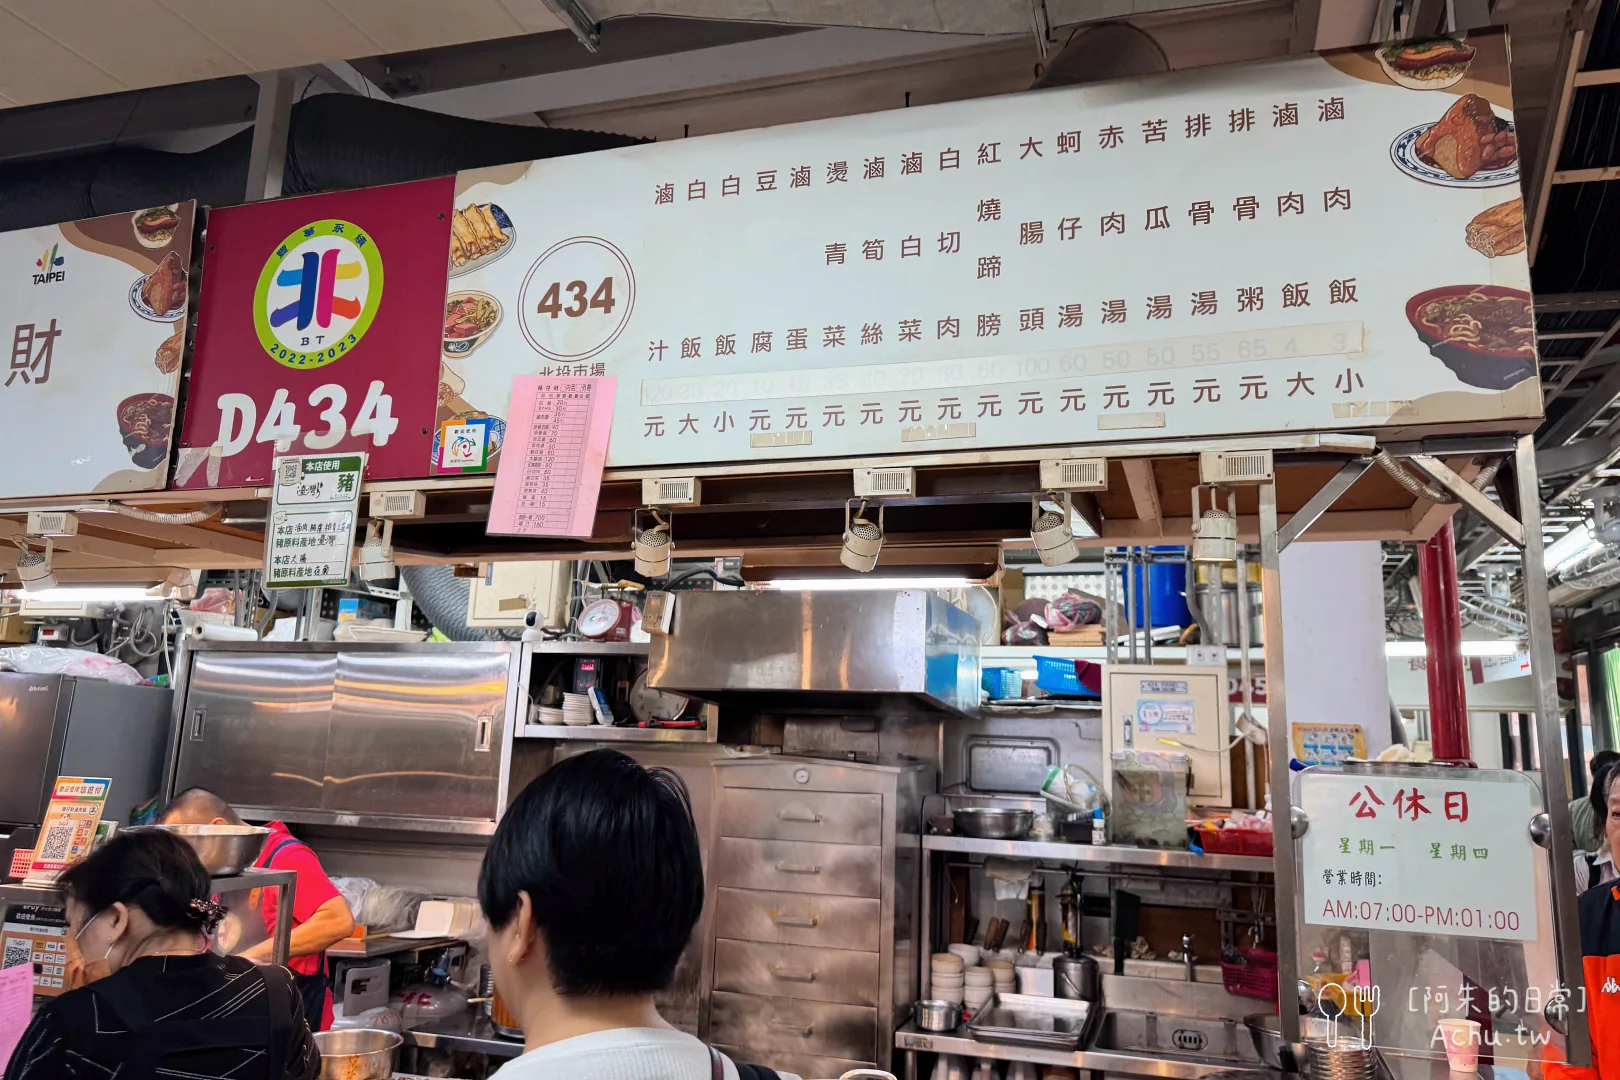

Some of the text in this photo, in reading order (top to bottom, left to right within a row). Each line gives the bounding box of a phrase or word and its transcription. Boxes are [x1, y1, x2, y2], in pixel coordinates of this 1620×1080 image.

[32, 271, 65, 285] TAIPEI
[537, 277, 615, 319] 434
[4, 318, 62, 387] 財
[270, 333, 357, 364] 2022-2023
[1102, 350, 1129, 369] 50
[1146, 346, 1174, 365] 50
[1191, 343, 1220, 361] 55
[1237, 339, 1267, 359] 65
[1060, 354, 1086, 371] 60
[1193, 379, 1220, 403] 元
[1240, 375, 1268, 400] 元
[1287, 372, 1315, 397] 大
[1335, 368, 1364, 393] 小
[1019, 392, 1043, 415] 元
[1060, 388, 1086, 412] 元
[1103, 385, 1129, 409] 元
[1148, 382, 1174, 406] 元
[823, 405, 845, 427] 元
[861, 403, 883, 425] 元
[899, 400, 922, 422] 元
[938, 398, 961, 420] 元
[978, 395, 1002, 417] 元
[209, 380, 399, 457] D434
[644, 416, 664, 437] 元
[679, 413, 699, 434] 大
[714, 411, 734, 432] 小
[749, 410, 770, 431] 元
[784, 407, 808, 429] 元
[305, 460, 341, 472] 本店使用
[337, 473, 355, 493] 豬
[277, 526, 293, 535] 本店
[275, 537, 317, 549] 豬原料產地
[274, 555, 290, 565] 本店
[273, 567, 313, 579] 豬原料產地
[1349, 785, 1468, 823] 公休日
[1338, 837, 1489, 861] 星期一 星期四
[1322, 868, 1382, 888] 營業時間:
[1322, 898, 1520, 931] AM:07:00-PM:01:00
